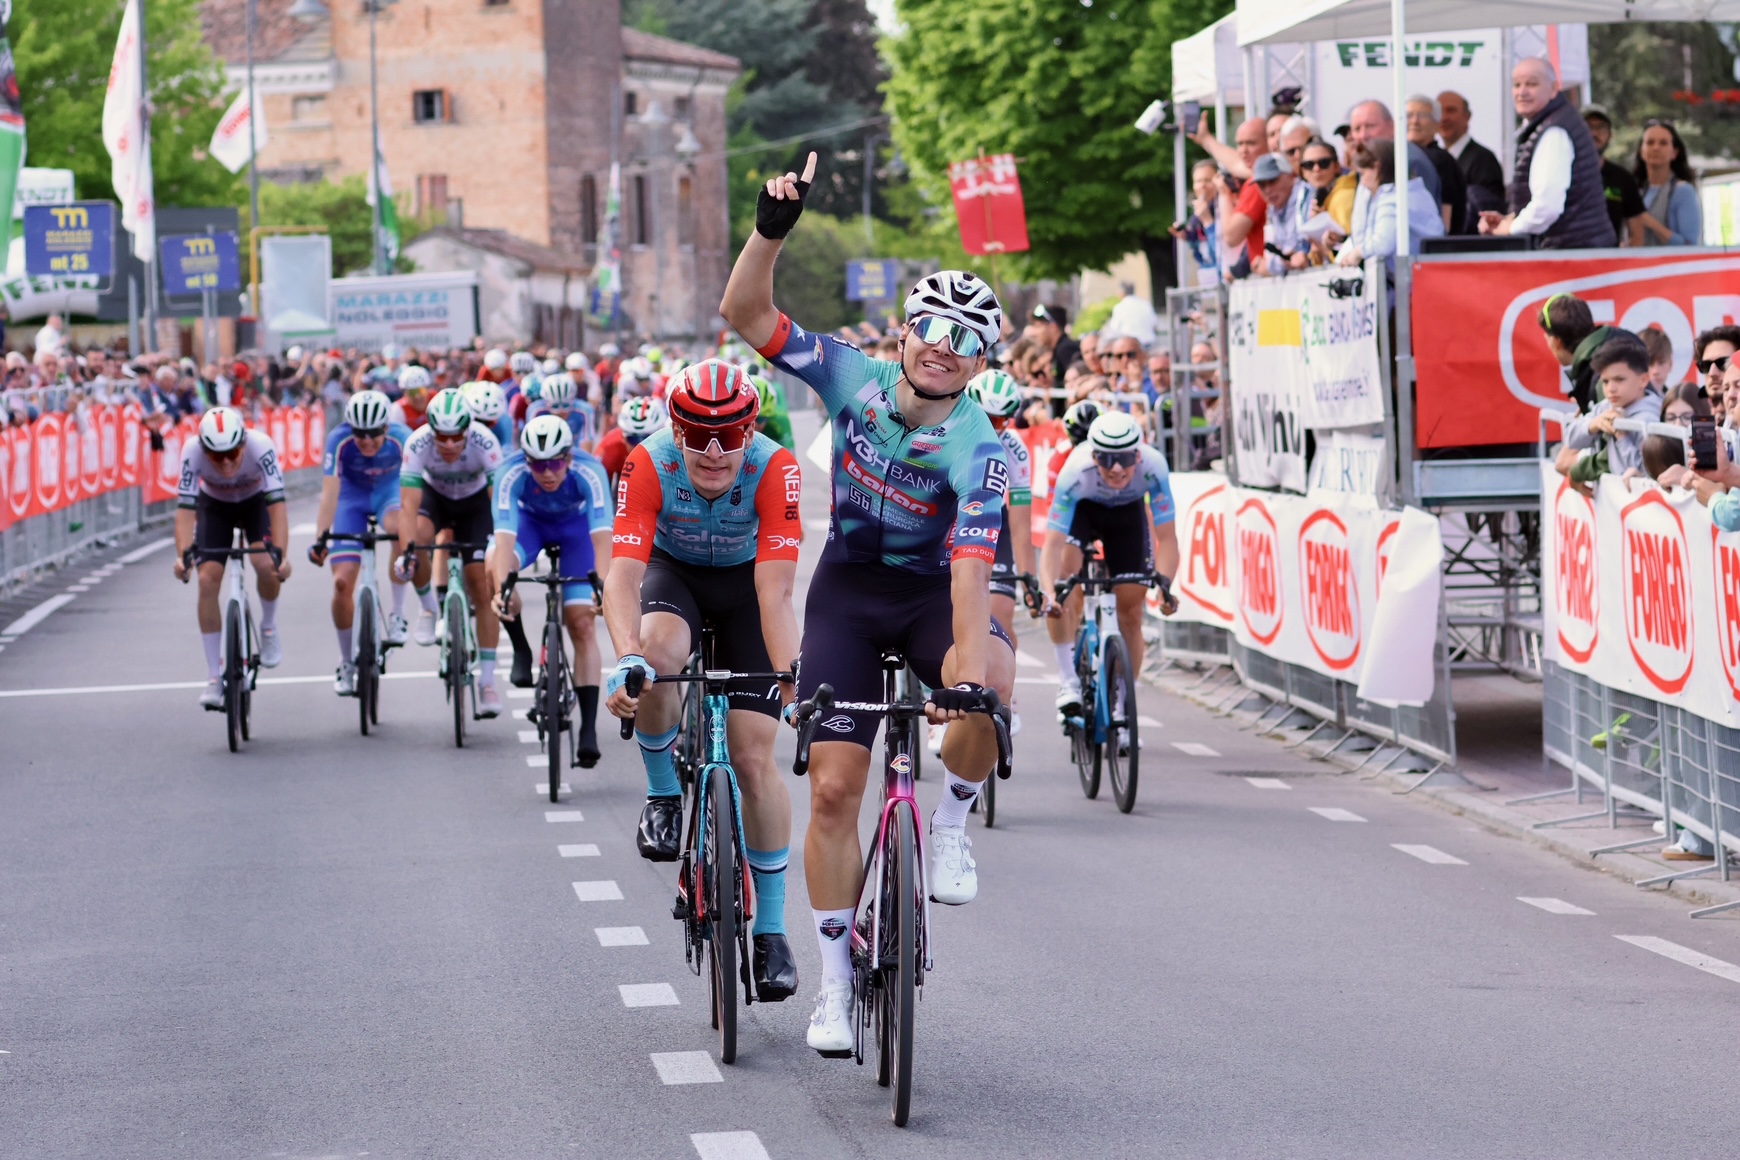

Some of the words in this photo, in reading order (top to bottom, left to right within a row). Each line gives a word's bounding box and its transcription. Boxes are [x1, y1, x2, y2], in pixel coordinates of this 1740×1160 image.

[890, 465, 941, 494] BANK
[613, 534, 641, 545] eda
[1628, 529, 1687, 654] FORIGO
[834, 701, 889, 711] Vision
